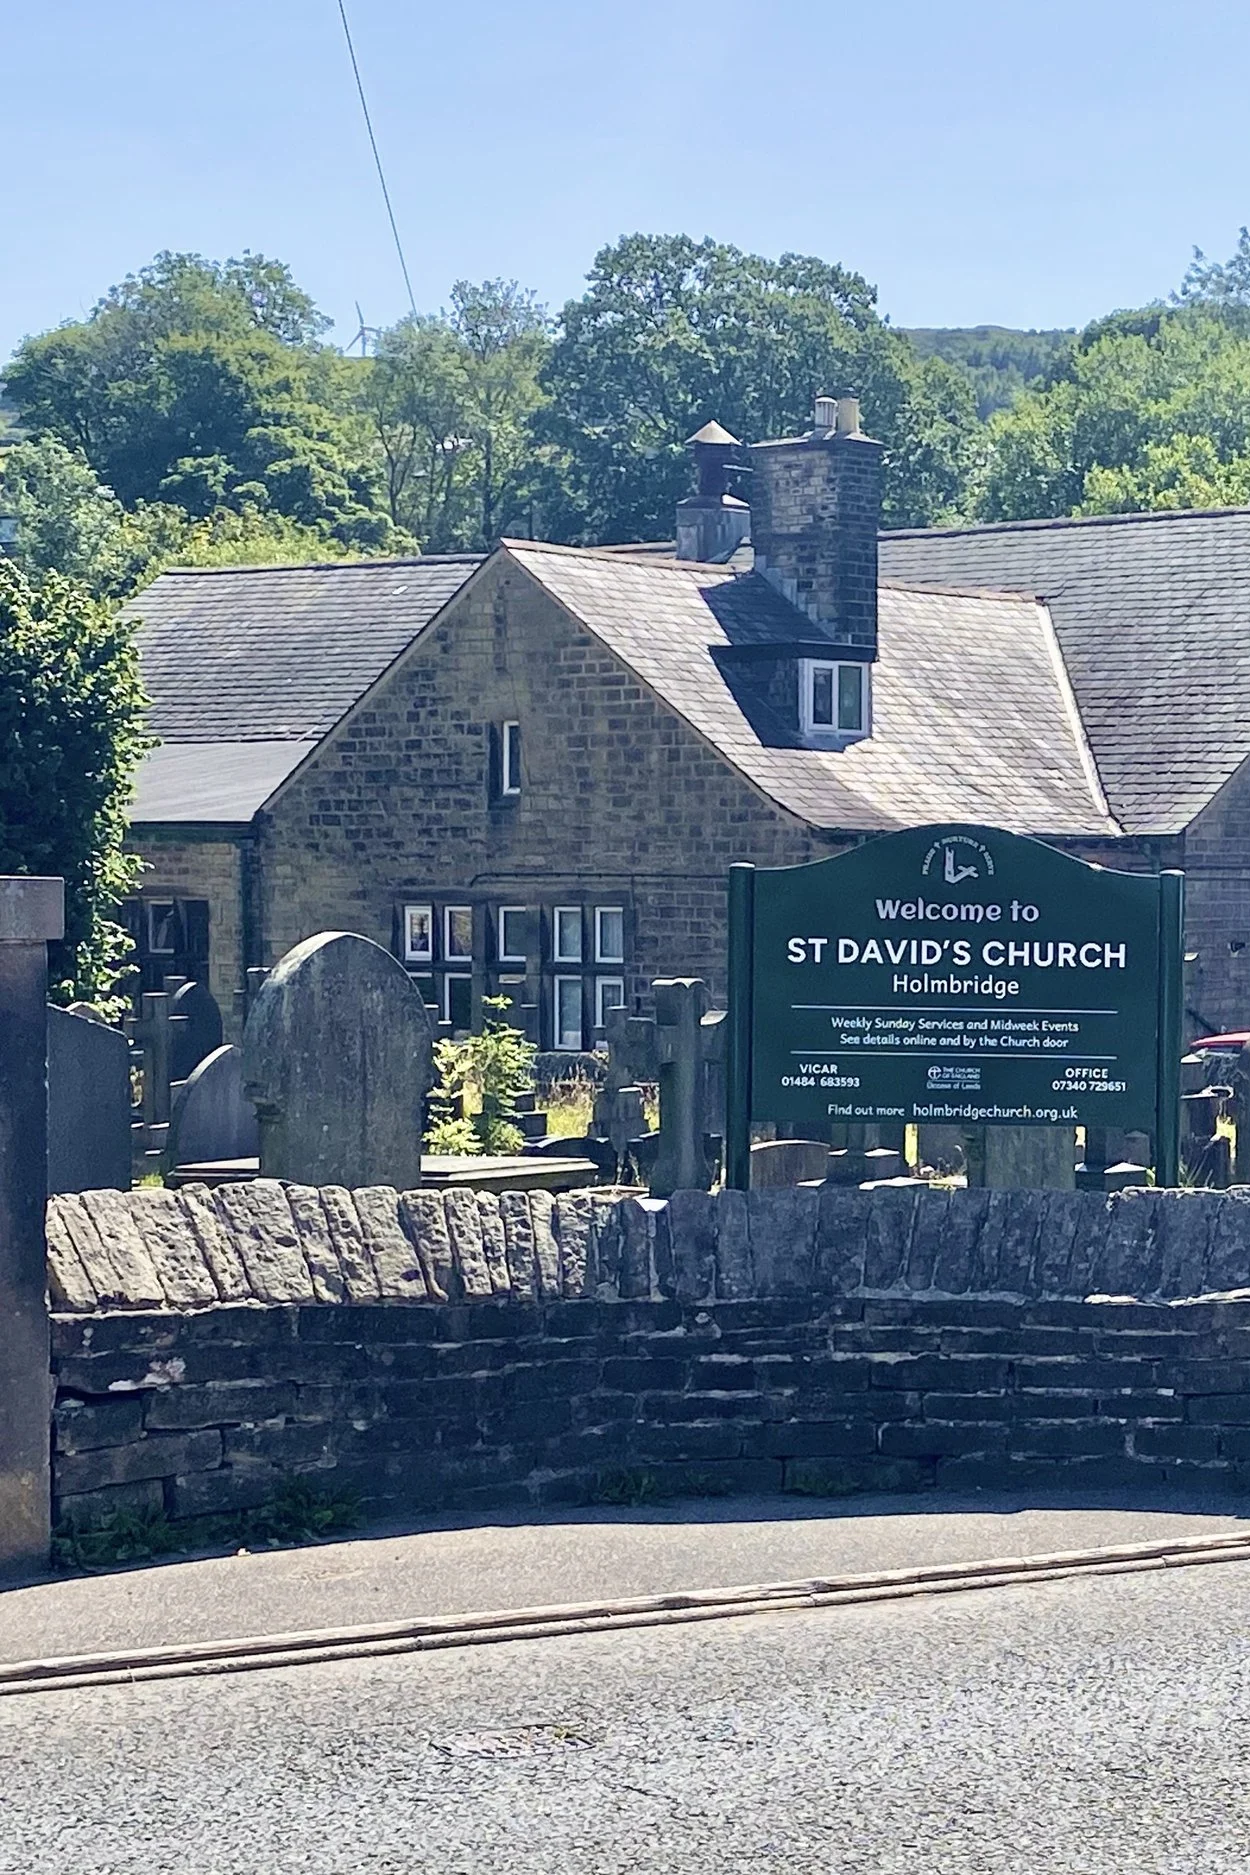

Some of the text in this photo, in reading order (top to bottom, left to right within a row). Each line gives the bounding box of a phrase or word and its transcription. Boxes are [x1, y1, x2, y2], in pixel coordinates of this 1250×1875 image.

[876, 897, 1039, 923] Welcome to
[788, 938, 1125, 967] ST DAVID'S CHURCH
[894, 973, 1018, 999] Holmbridge
[832, 1017, 1078, 1031] Weekly Sunday Services and Midweek Events
[840, 1033, 1068, 1048] See details online and by the Church door
[800, 1064, 837, 1074] VICAR
[1065, 1068, 1108, 1078] OFFICE
[782, 1076, 859, 1087] 01484 683593
[1052, 1080, 1125, 1091] 07340 729651
[828, 1103, 1077, 1121] Find out more holmbridgechurch.org.uk
